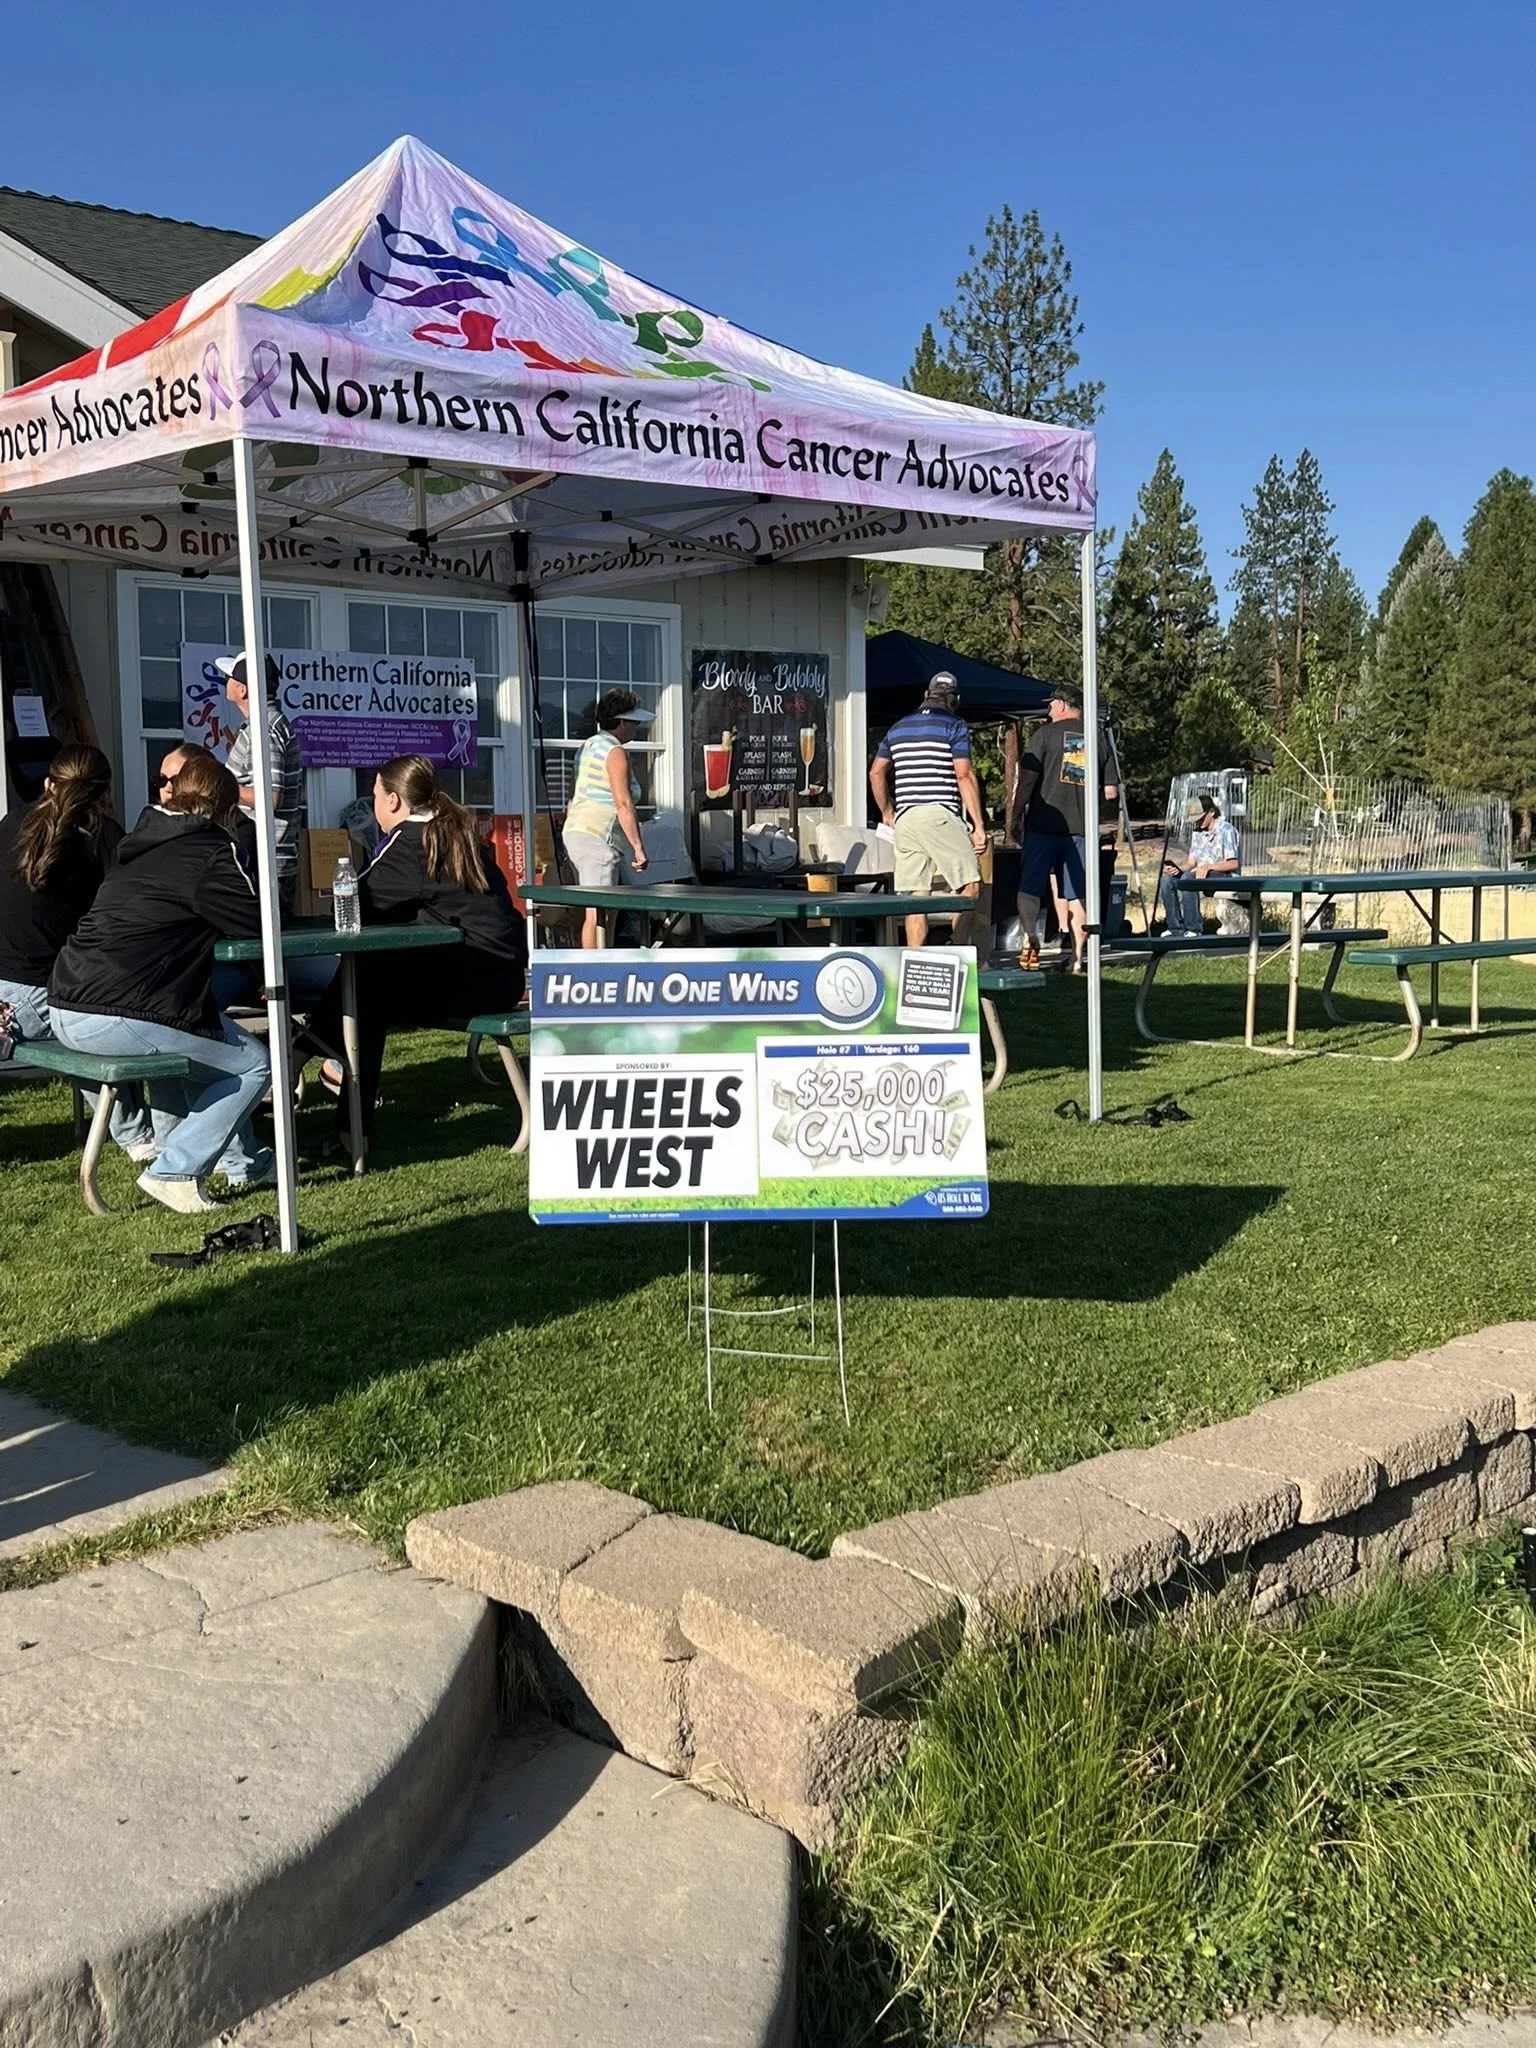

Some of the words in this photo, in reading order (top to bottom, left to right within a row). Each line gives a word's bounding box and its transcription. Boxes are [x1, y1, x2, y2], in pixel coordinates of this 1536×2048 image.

[51, 372, 202, 449] Advocates
[289, 351, 524, 438] Northern
[536, 389, 746, 464] California
[756, 418, 892, 482] Cancer
[897, 438, 1069, 503] Advocates
[372, 659, 472, 688] California
[698, 661, 758, 697] Bloody
[772, 663, 826, 698] Bubbly
[283, 684, 364, 712] Cancer
[368, 687, 475, 715] Advocates
[752, 694, 785, 715] BAR
[513, 819, 523, 873] GRIDDLE
[615, 1062, 659, 1070] SPONSORED
[660, 1062, 673, 1070] BY:
[816, 1045, 837, 1055] Hole
[838, 1045, 851, 1055] #7
[902, 1044, 920, 1054] 160
[541, 1075, 743, 1131] WHEELS
[795, 1067, 945, 1111] $25,000
[795, 1110, 946, 1157] CASH!
[575, 1134, 714, 1189] WEST
